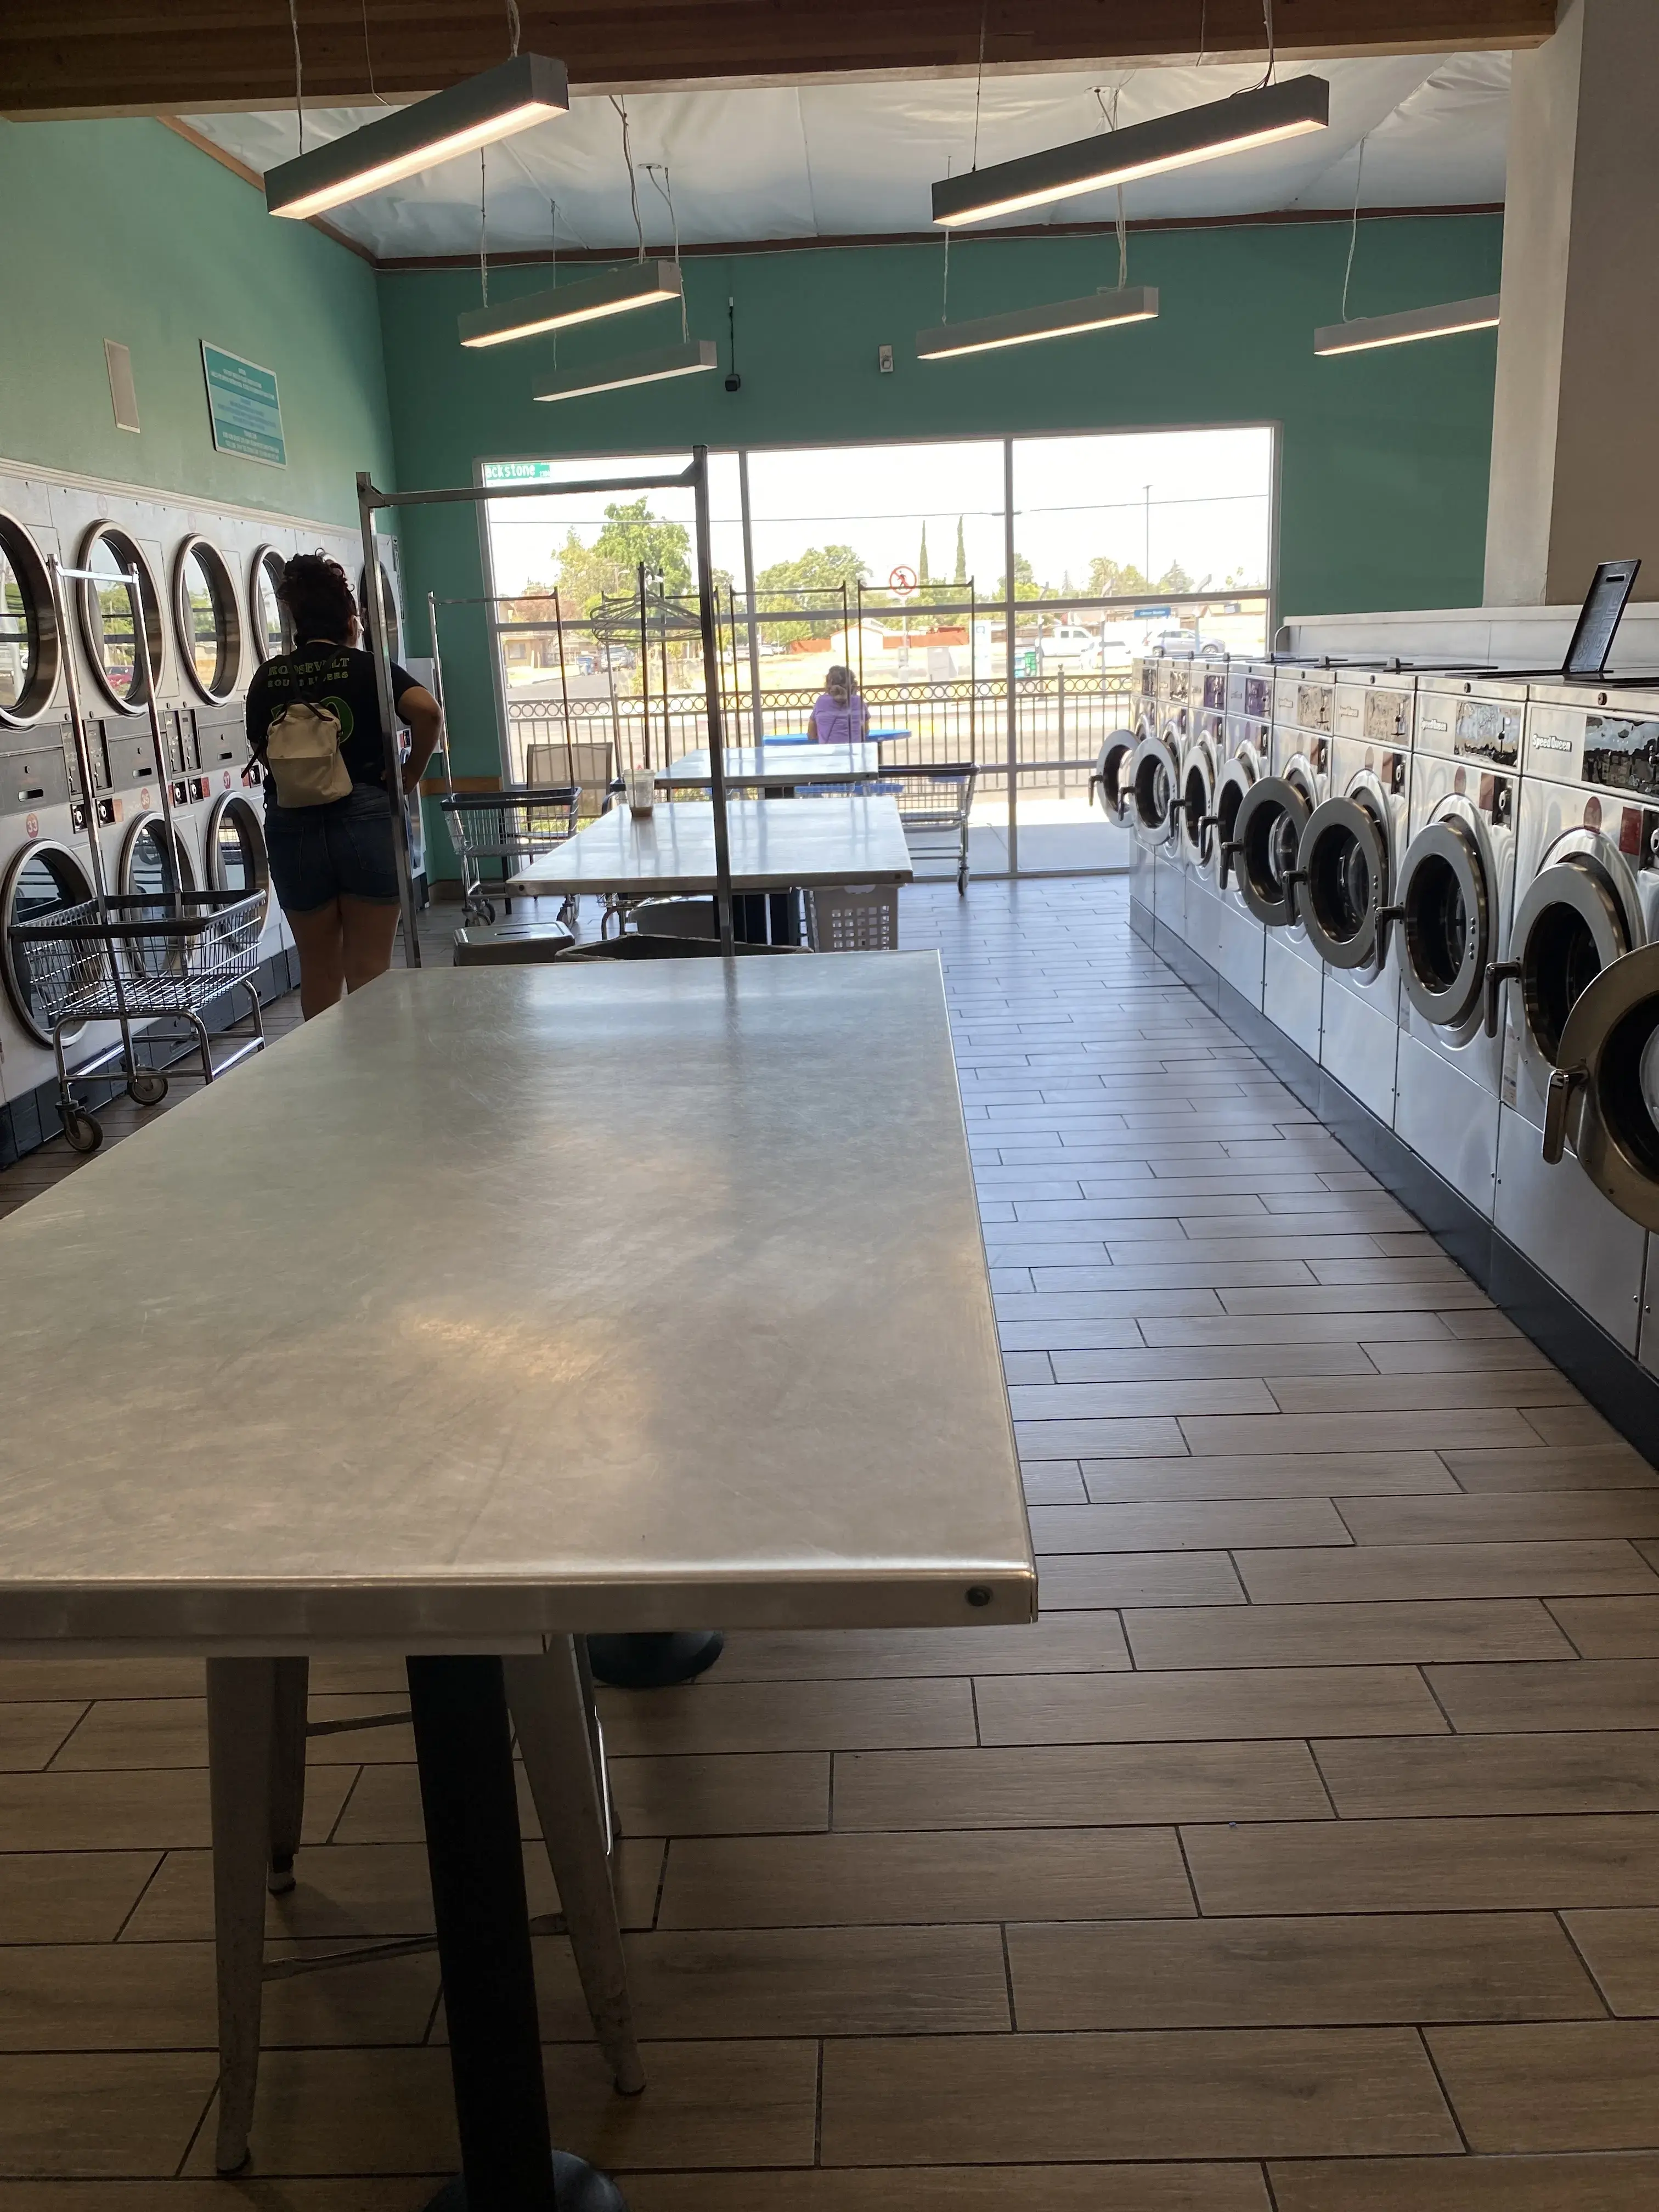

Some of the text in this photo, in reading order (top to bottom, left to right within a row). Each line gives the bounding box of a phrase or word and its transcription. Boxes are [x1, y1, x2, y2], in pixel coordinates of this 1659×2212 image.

[1533, 734, 1571, 751] Speed Queen
[223, 775, 230, 786] 37
[142, 793, 149, 804] 35
[28, 820, 38, 830] 33
